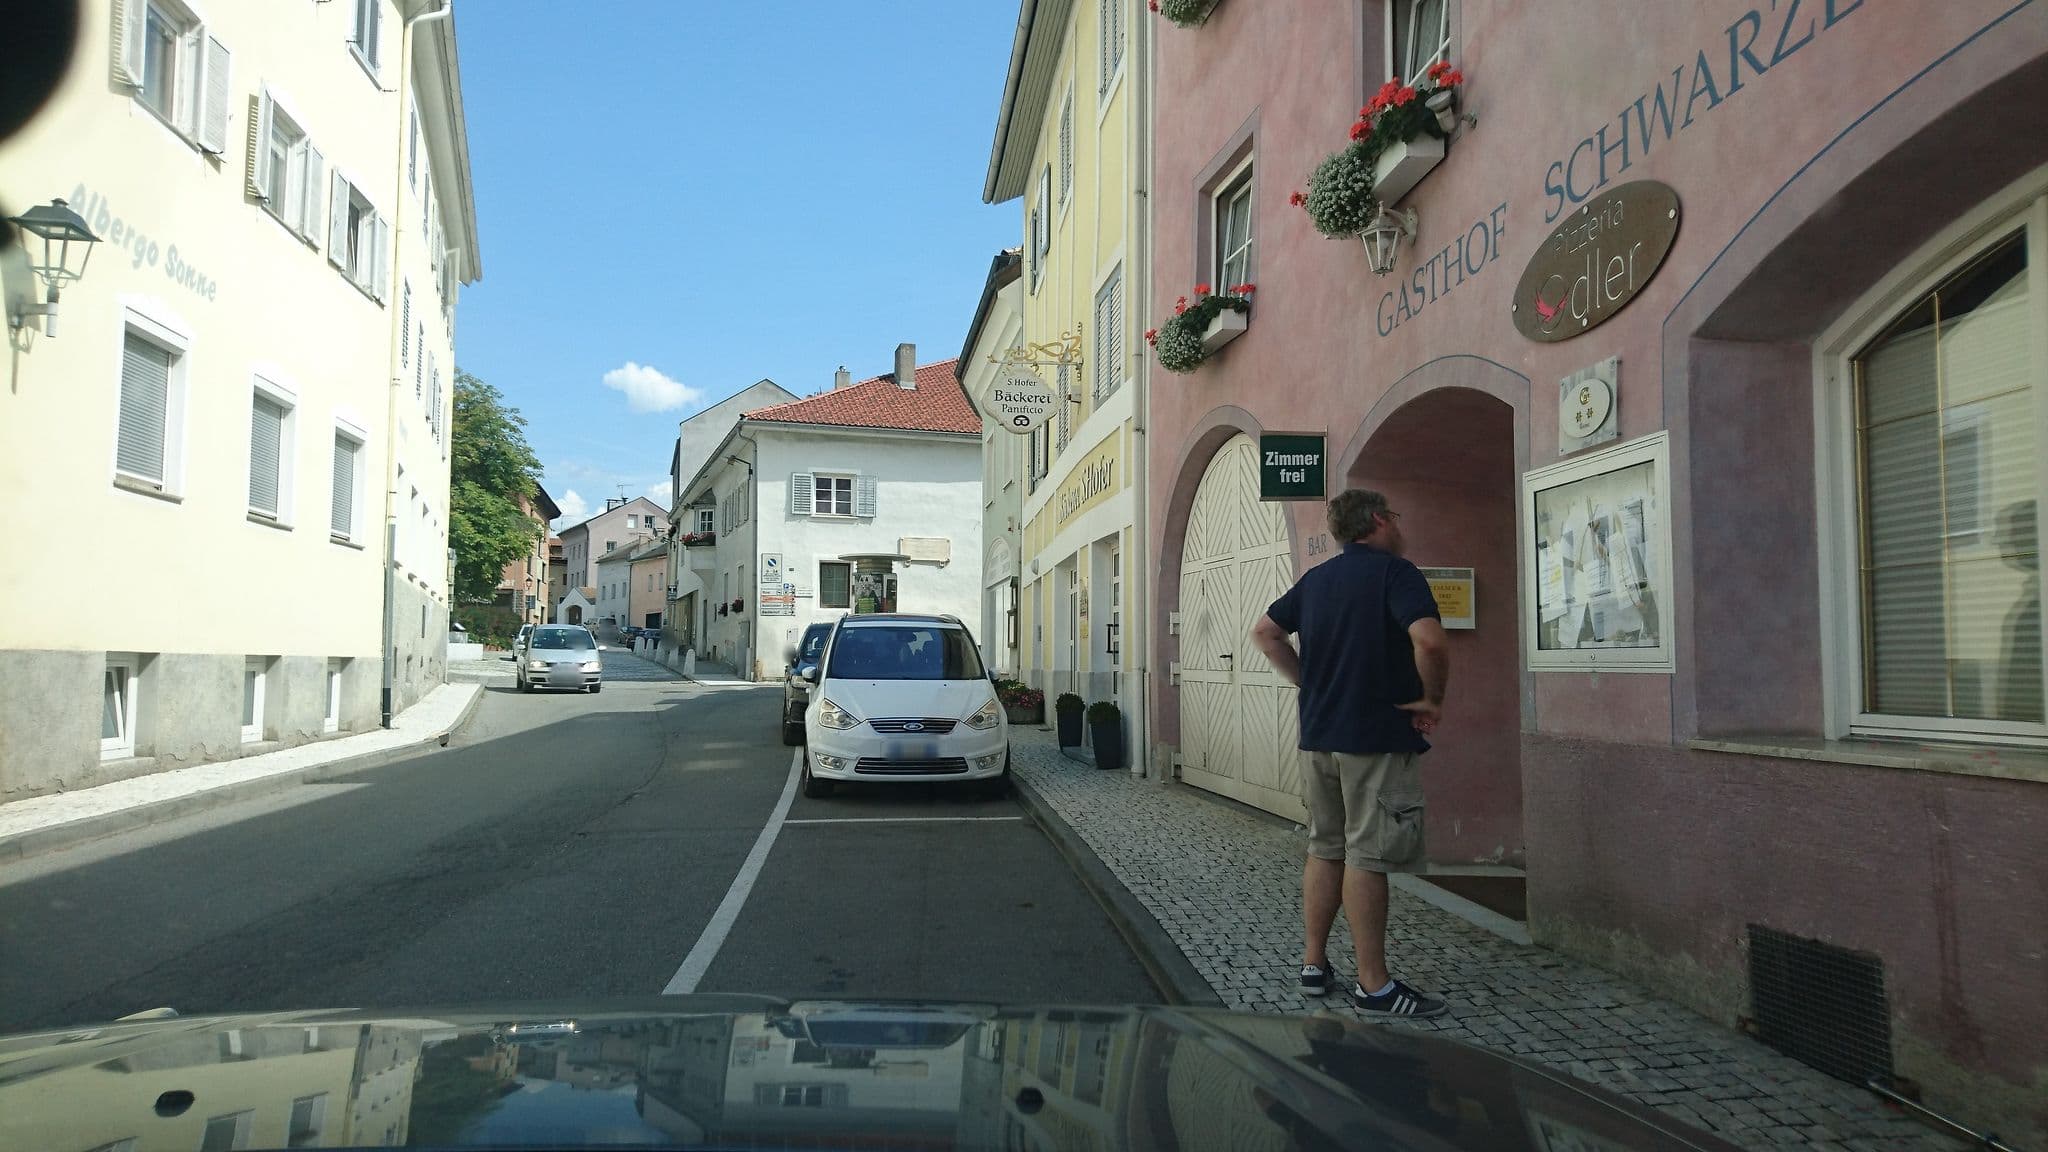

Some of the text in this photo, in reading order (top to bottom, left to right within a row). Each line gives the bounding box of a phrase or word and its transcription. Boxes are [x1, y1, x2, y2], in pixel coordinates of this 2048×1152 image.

[68, 183, 217, 302] Albergo Sonne
[1376, 202, 1508, 338] GASTHOF
[1014, 379, 1037, 387] Hofer
[994, 390, 1052, 403] Bäckerei
[1001, 404, 1044, 414] Panificio
[1265, 451, 1320, 466] Zimmer
[1279, 468, 1305, 483] frei
[1307, 533, 1328, 556] BAR
